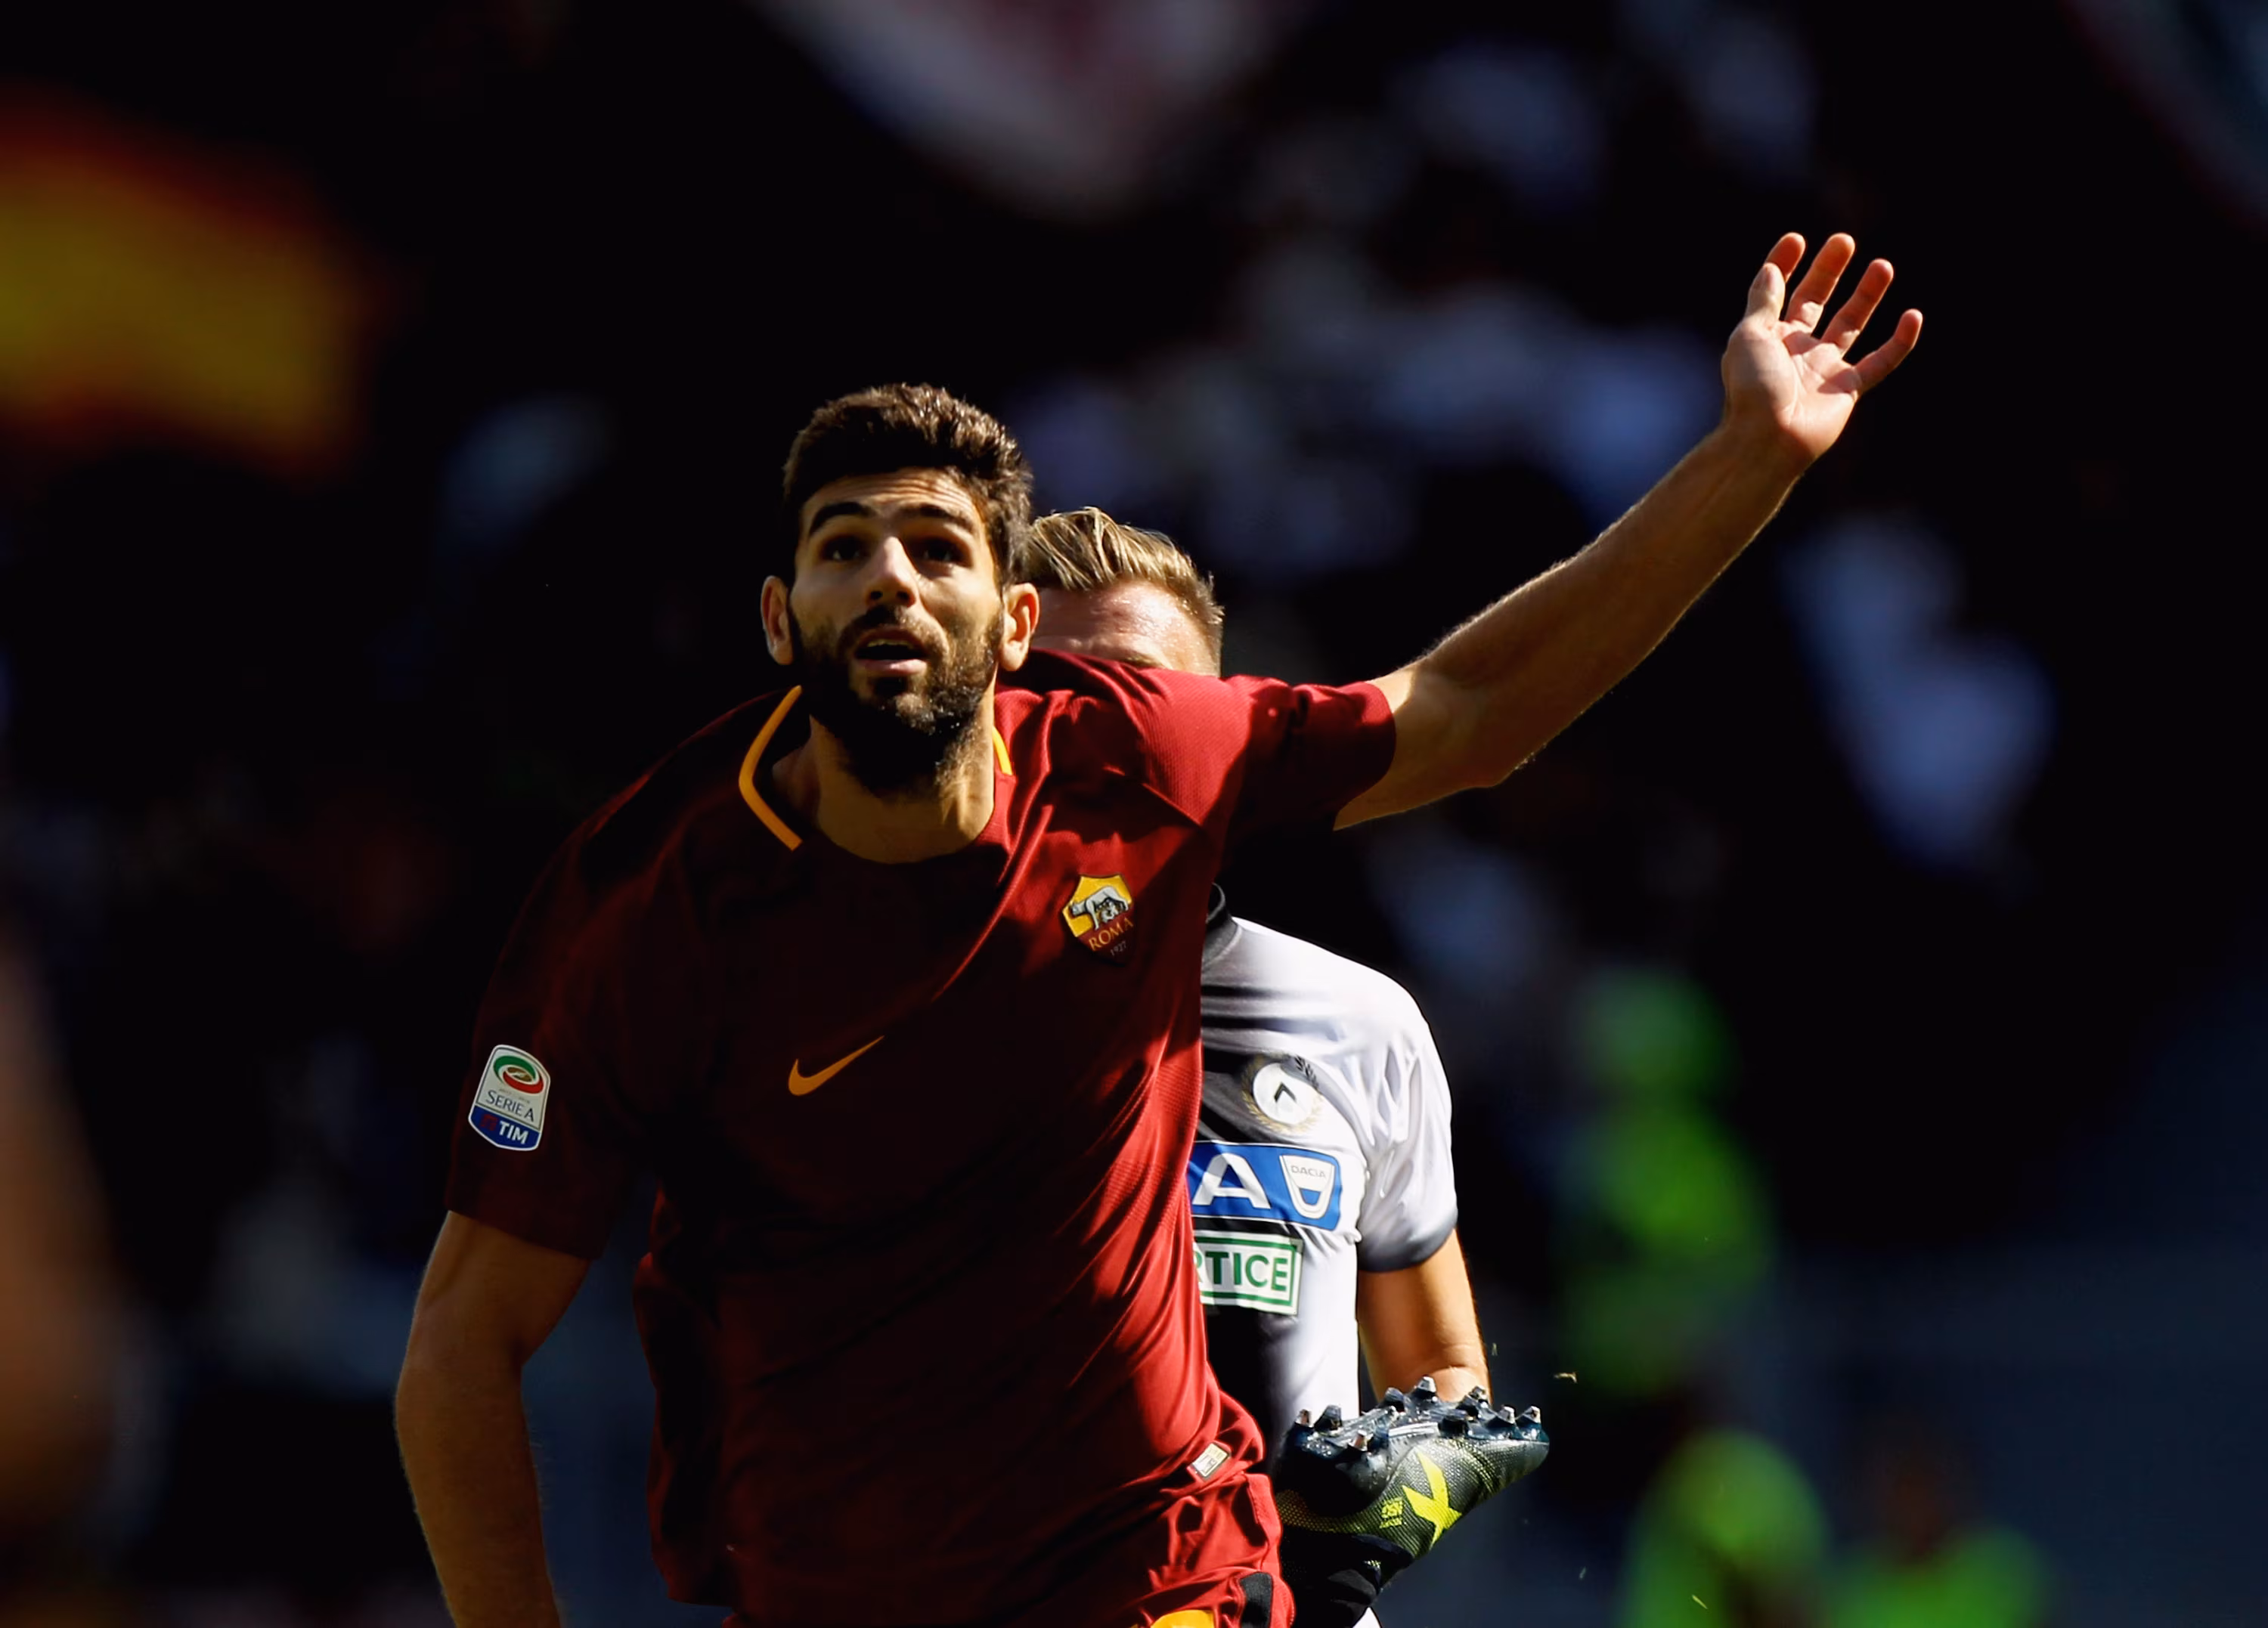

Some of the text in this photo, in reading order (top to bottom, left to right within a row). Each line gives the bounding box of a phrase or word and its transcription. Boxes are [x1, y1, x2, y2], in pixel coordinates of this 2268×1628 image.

[1089, 917, 1133, 952] ROMA
[485, 1089, 525, 1117] SERIE
[524, 1106, 534, 1122] A
[499, 1120, 528, 1144] TIM
[1290, 1165, 1326, 1179] DACIA
